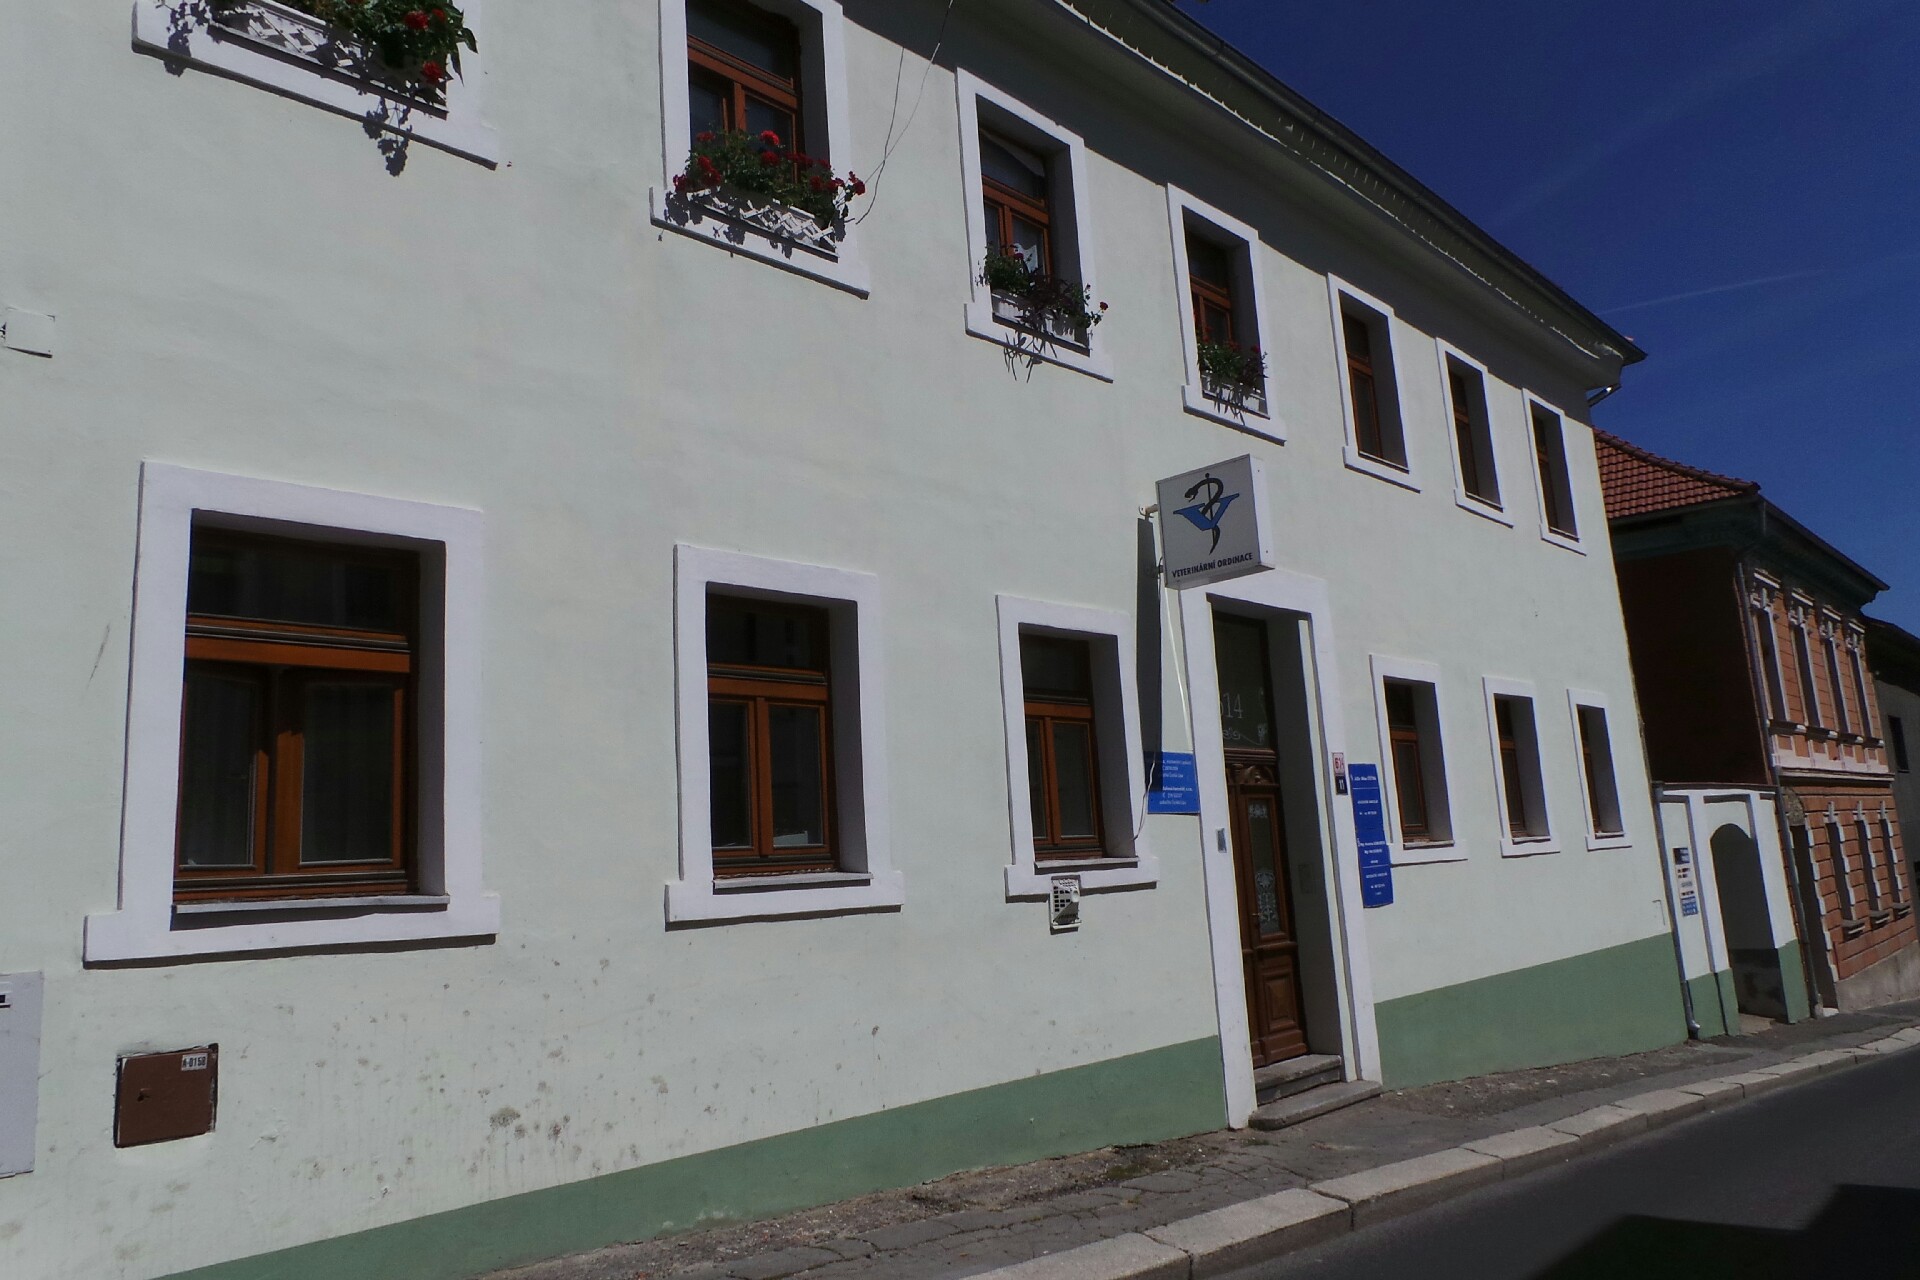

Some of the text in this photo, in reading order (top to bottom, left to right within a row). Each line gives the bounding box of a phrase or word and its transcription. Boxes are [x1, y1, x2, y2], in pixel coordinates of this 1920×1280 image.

[1171, 552, 1253, 578] VETERINÁRNÍ ORDINACE
[1222, 692, 1244, 719] 14
